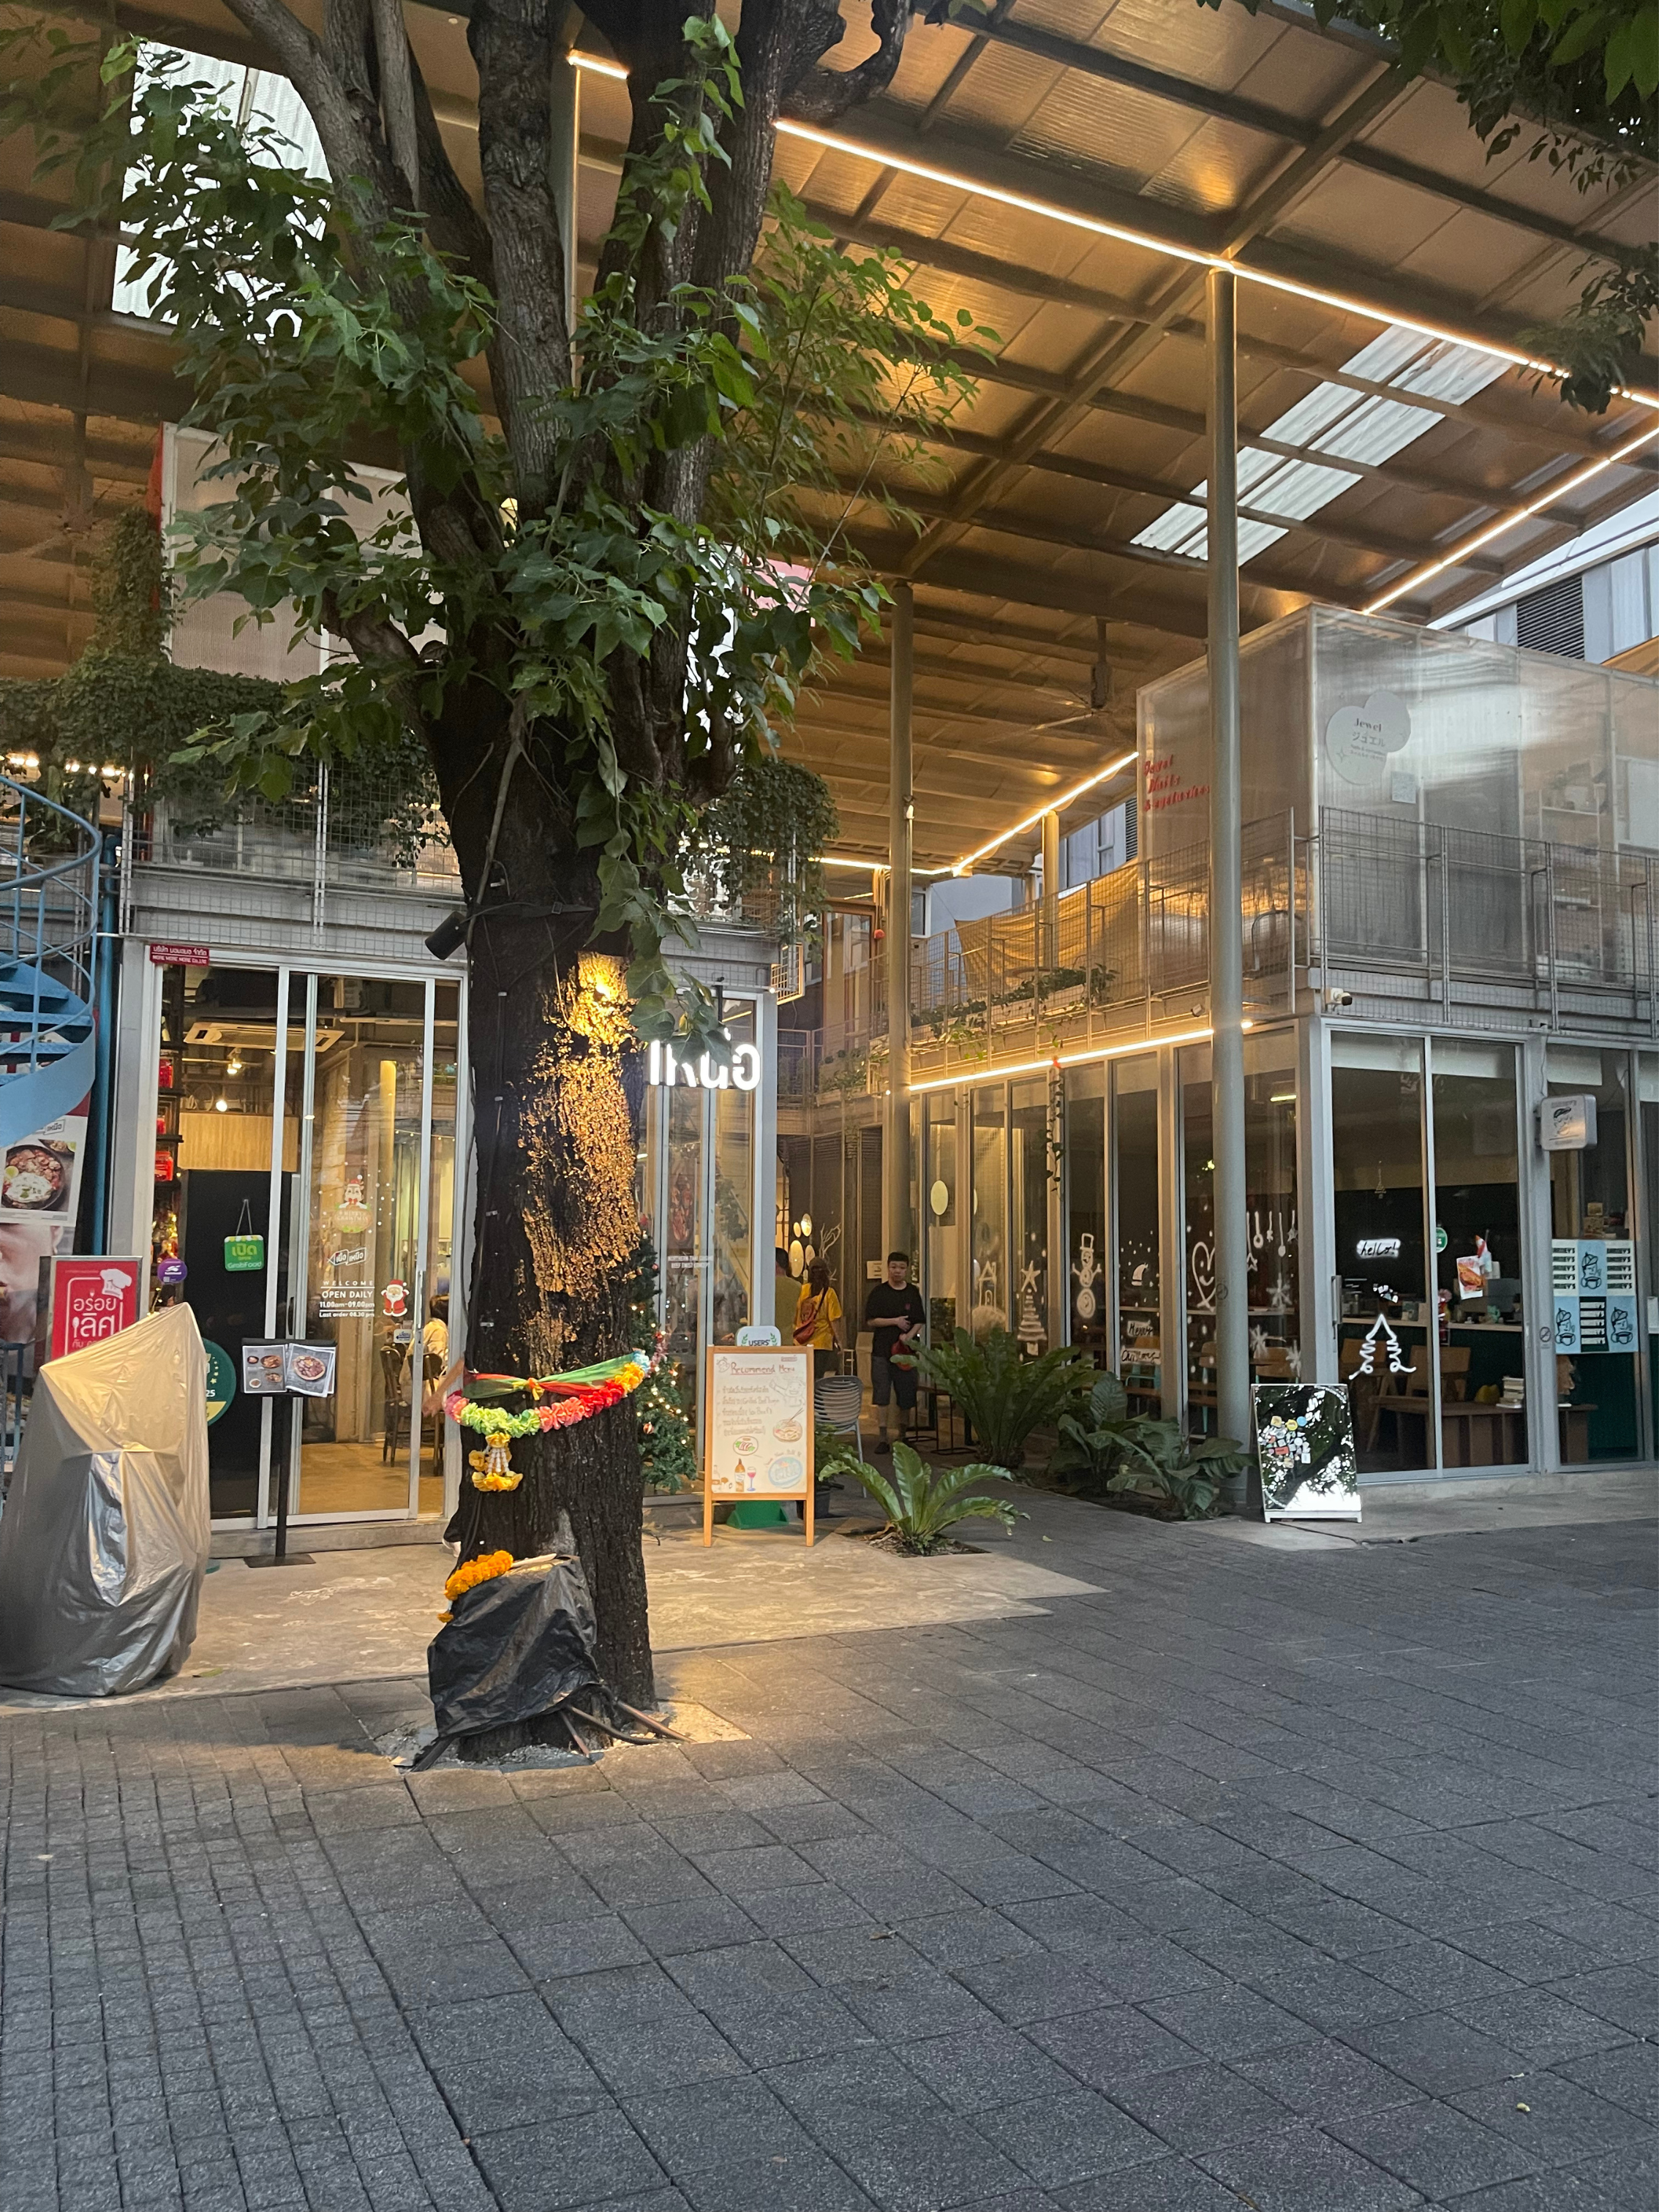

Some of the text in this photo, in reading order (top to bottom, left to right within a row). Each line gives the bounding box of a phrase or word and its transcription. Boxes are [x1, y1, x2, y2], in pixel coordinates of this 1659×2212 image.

[1354, 718, 1382, 732] Jewel
[227, 1261, 262, 1269] GrabFood
[349, 1290, 373, 1298] DAILY
[731, 1361, 795, 1374] Recommend Menu
